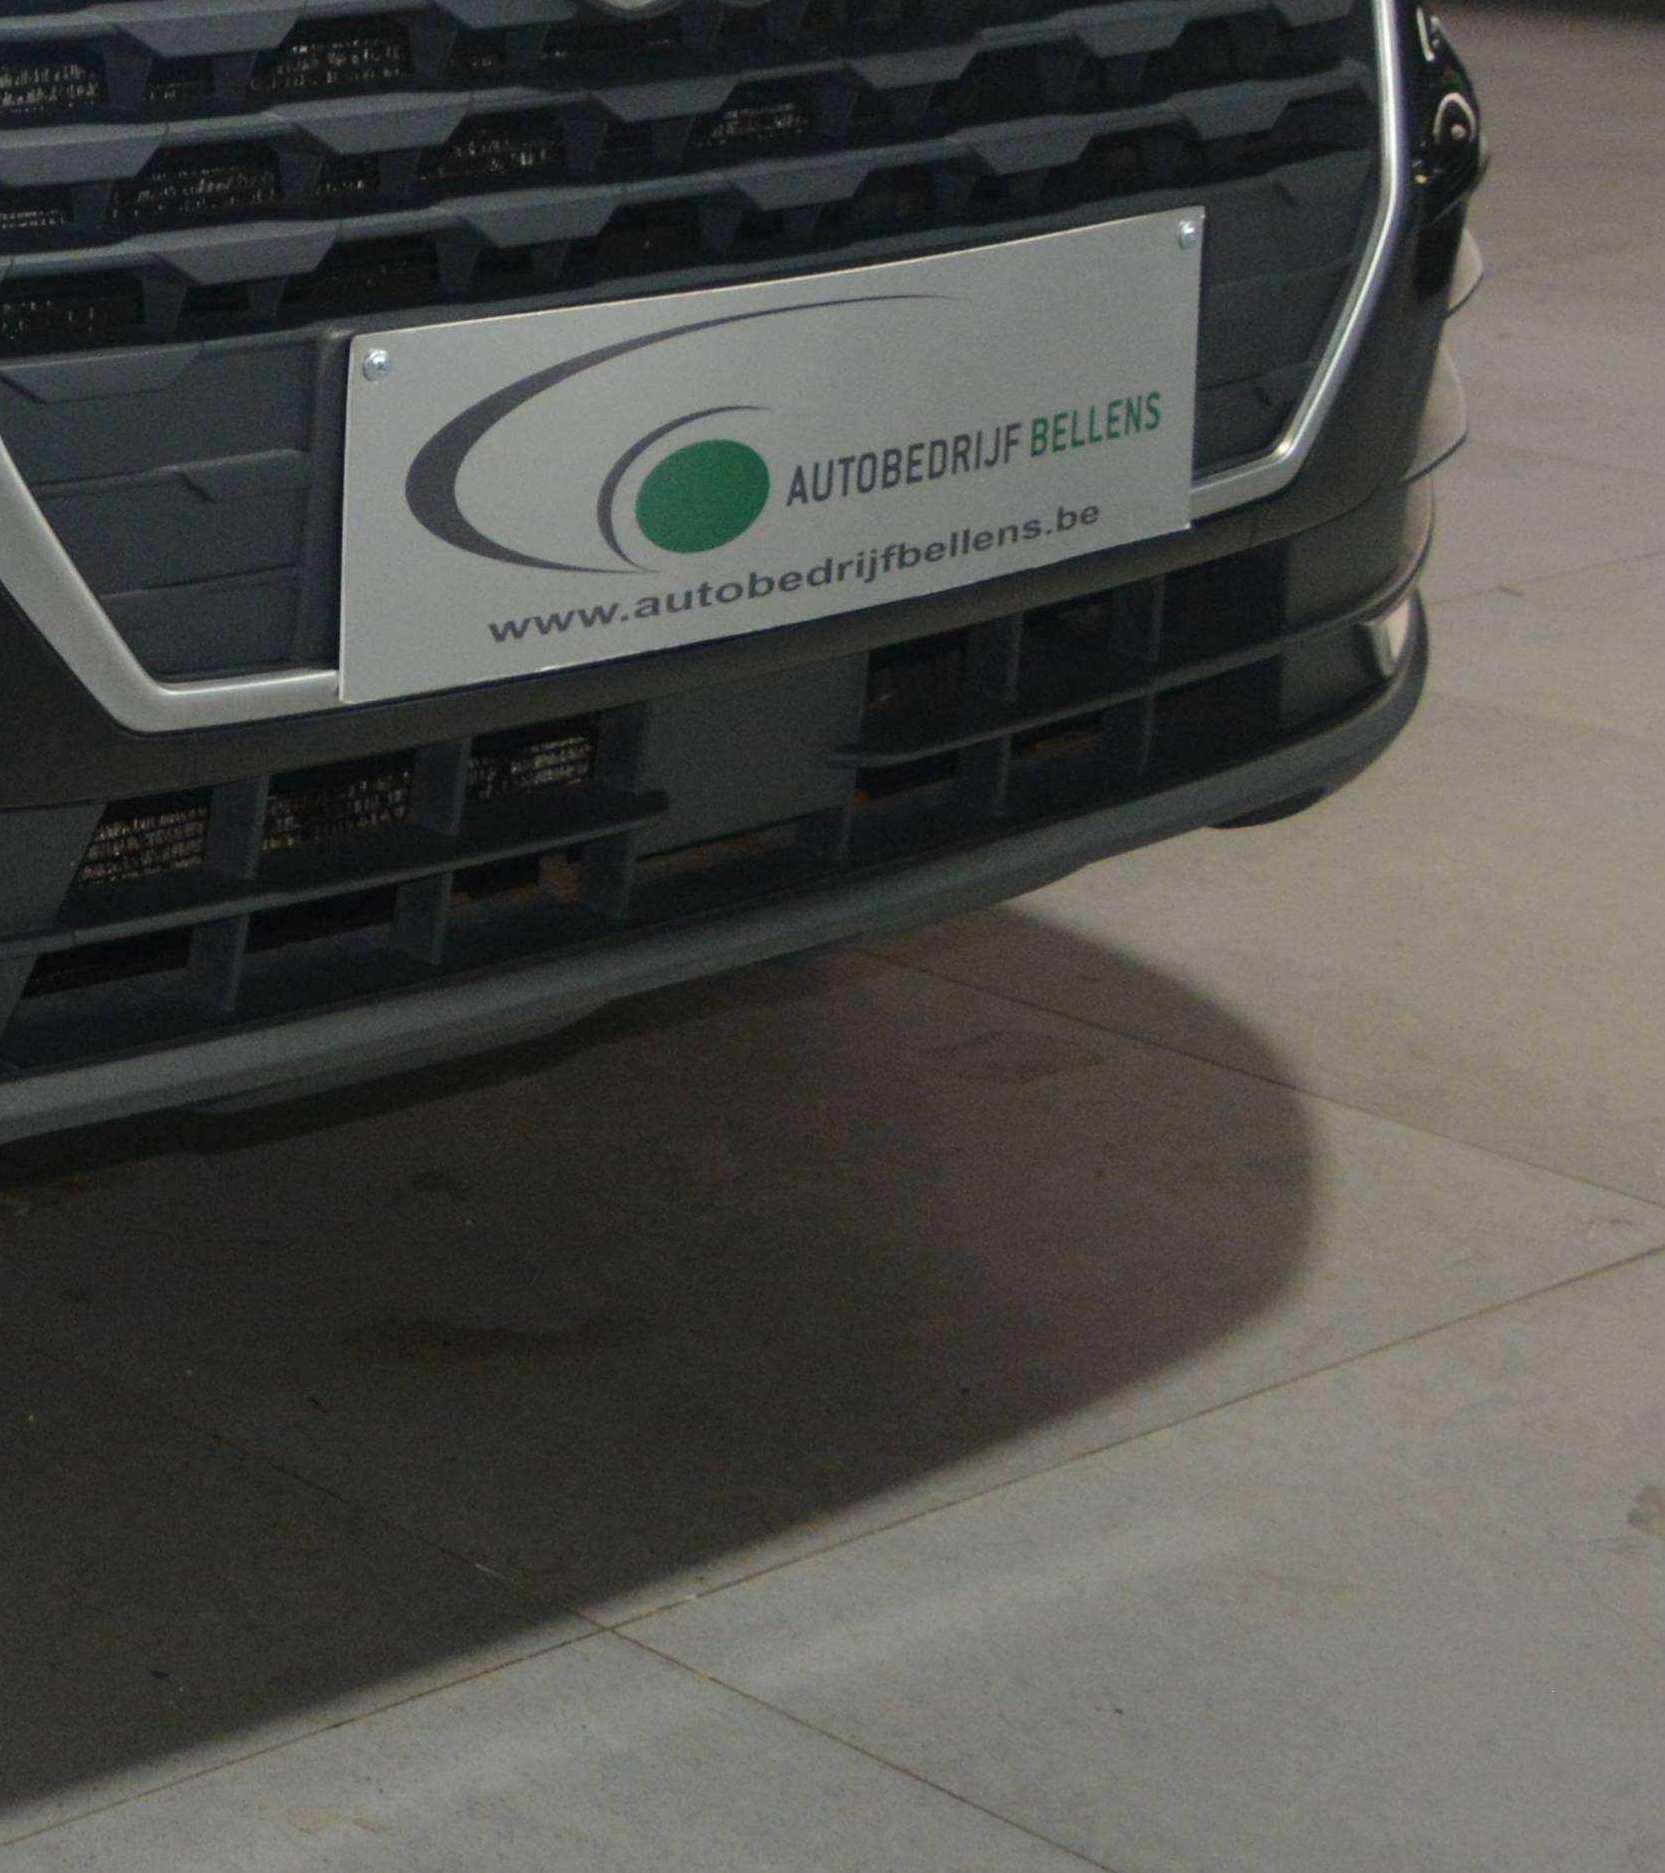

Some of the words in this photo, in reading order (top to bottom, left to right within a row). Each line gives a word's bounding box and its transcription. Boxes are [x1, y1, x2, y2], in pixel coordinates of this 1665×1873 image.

[785, 422, 1022, 508] AUTOBEDRIJF
[1030, 390, 1162, 458] BELLENS
[487, 502, 1102, 645] www.autobedrijfbellens.be
